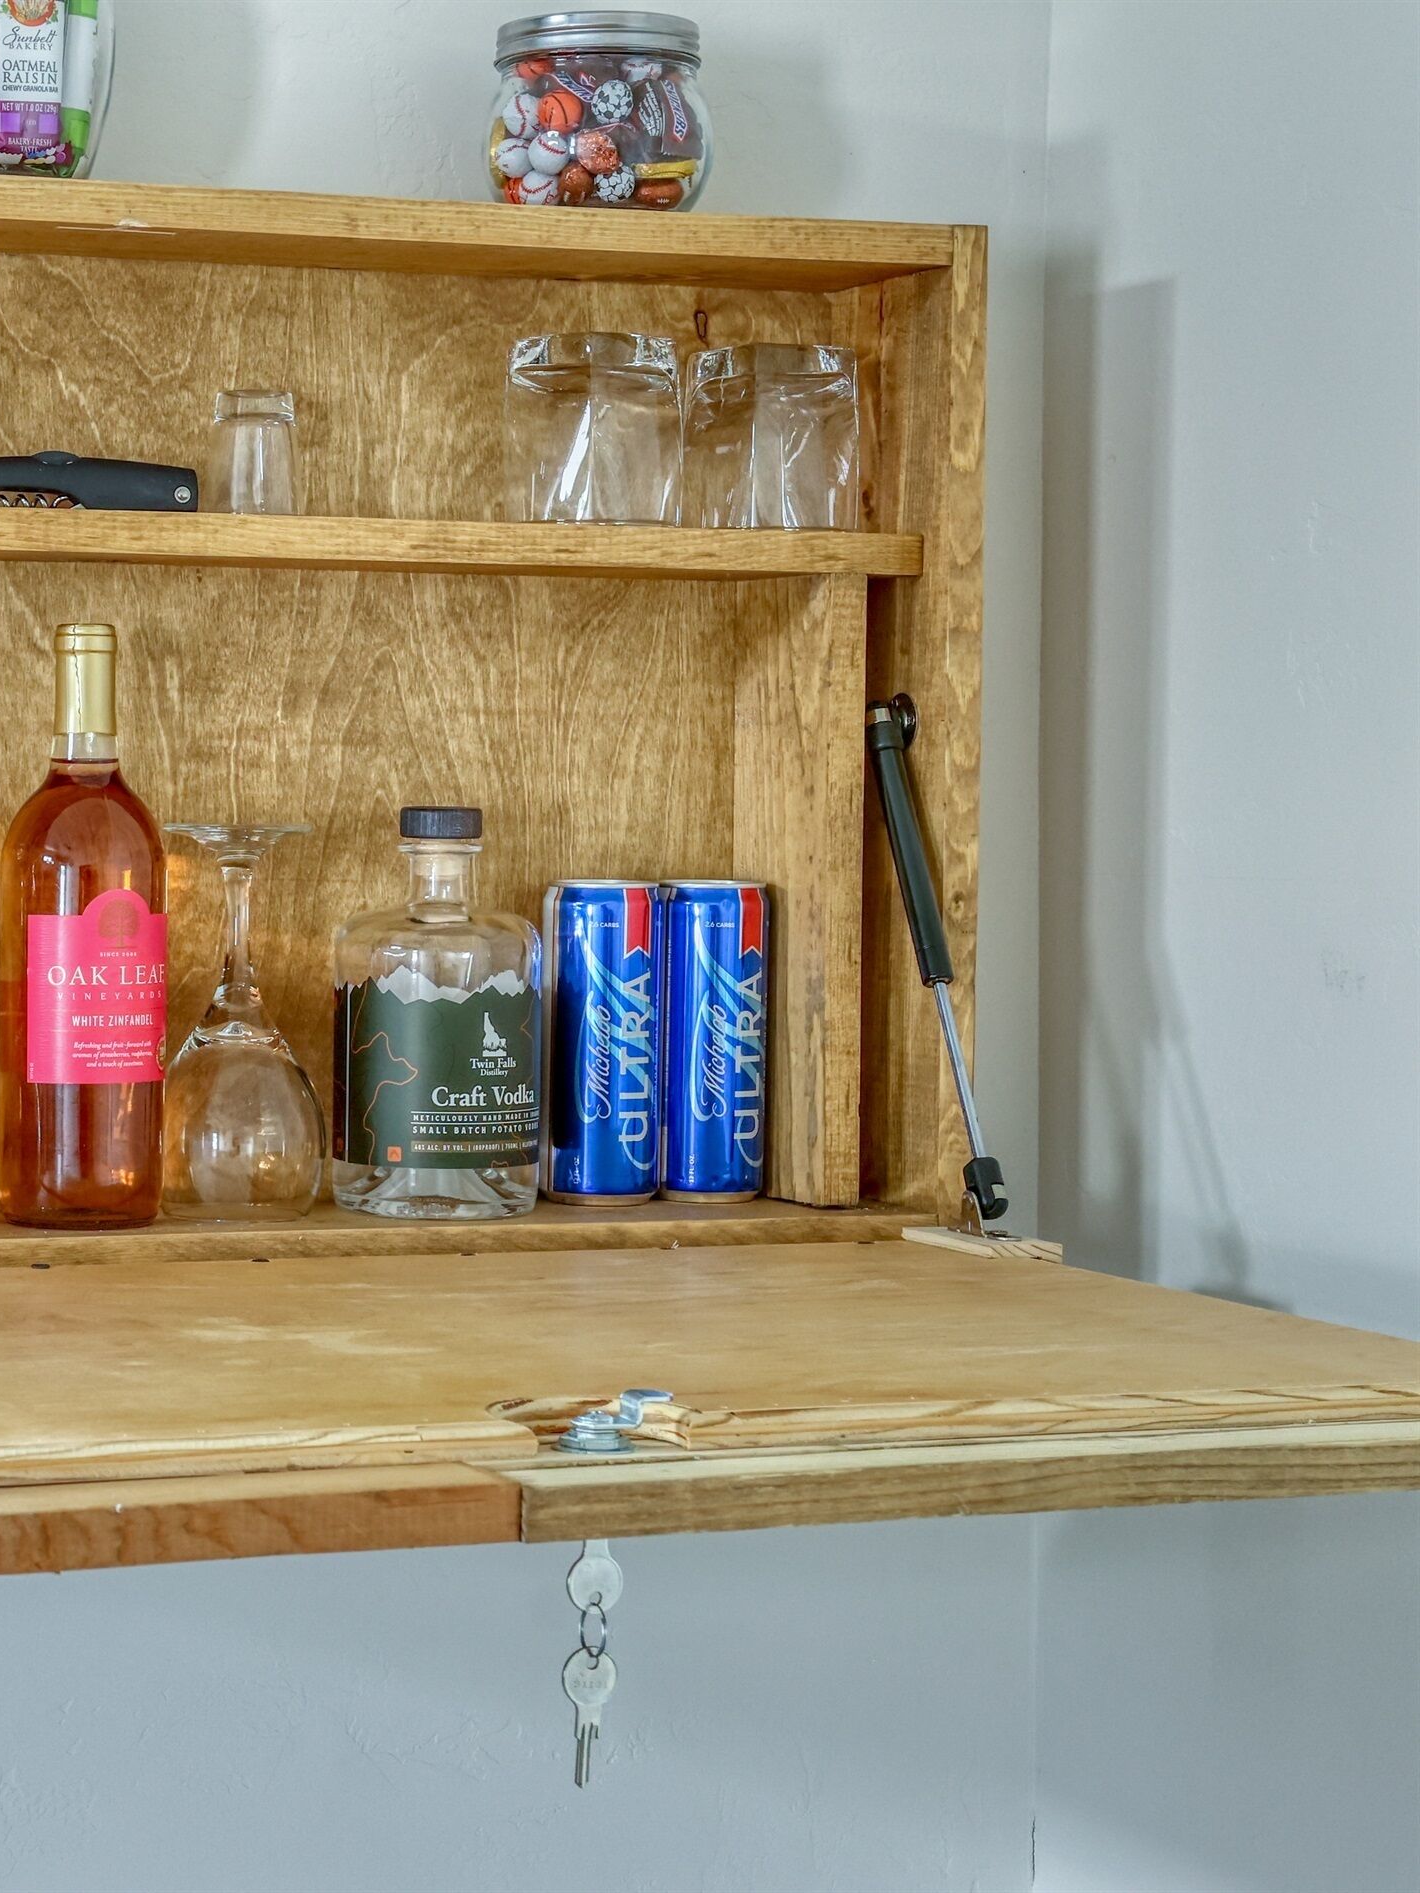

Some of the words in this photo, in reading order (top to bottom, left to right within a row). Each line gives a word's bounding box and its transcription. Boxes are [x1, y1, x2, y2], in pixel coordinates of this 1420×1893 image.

[2, 26, 57, 45] Sunbelt
[9, 42, 52, 51] BAKERY
[2, 59, 58, 73] OATMEAL
[3, 72, 57, 84] RAISIN
[2, 103, 14, 111] NET
[14, 103, 24, 112] WT
[35, 103, 43, 112] OZ
[8, 137, 52, 146] BAKERY-FRESH
[47, 965, 108, 986] OAK
[119, 964, 165, 985] LEAF
[57, 990, 161, 1000] VINEYARDS
[72, 1015, 104, 1026] WHITE
[108, 1014, 153, 1026] ZINFANDEL
[618, 969, 650, 1142] ULTRA
[701, 1004, 727, 1117] Michelob
[733, 969, 762, 1141] ULTRA
[117, 1060, 123, 1069] of
[469, 1058, 494, 1069] Twin
[497, 1057, 516, 1068] Falls
[585, 1004, 611, 1119] Michelob
[480, 1068, 509, 1077] Distillery
[431, 1085, 487, 1107] Craft
[491, 1083, 534, 1106] Vodka
[413, 1114, 479, 1122] METICULOUSLY
[482, 1113, 502, 1121] HAND
[412, 1125, 447, 1134] SMALL
[454, 1125, 487, 1134] BATCH
[492, 1124, 522, 1134] POTATO
